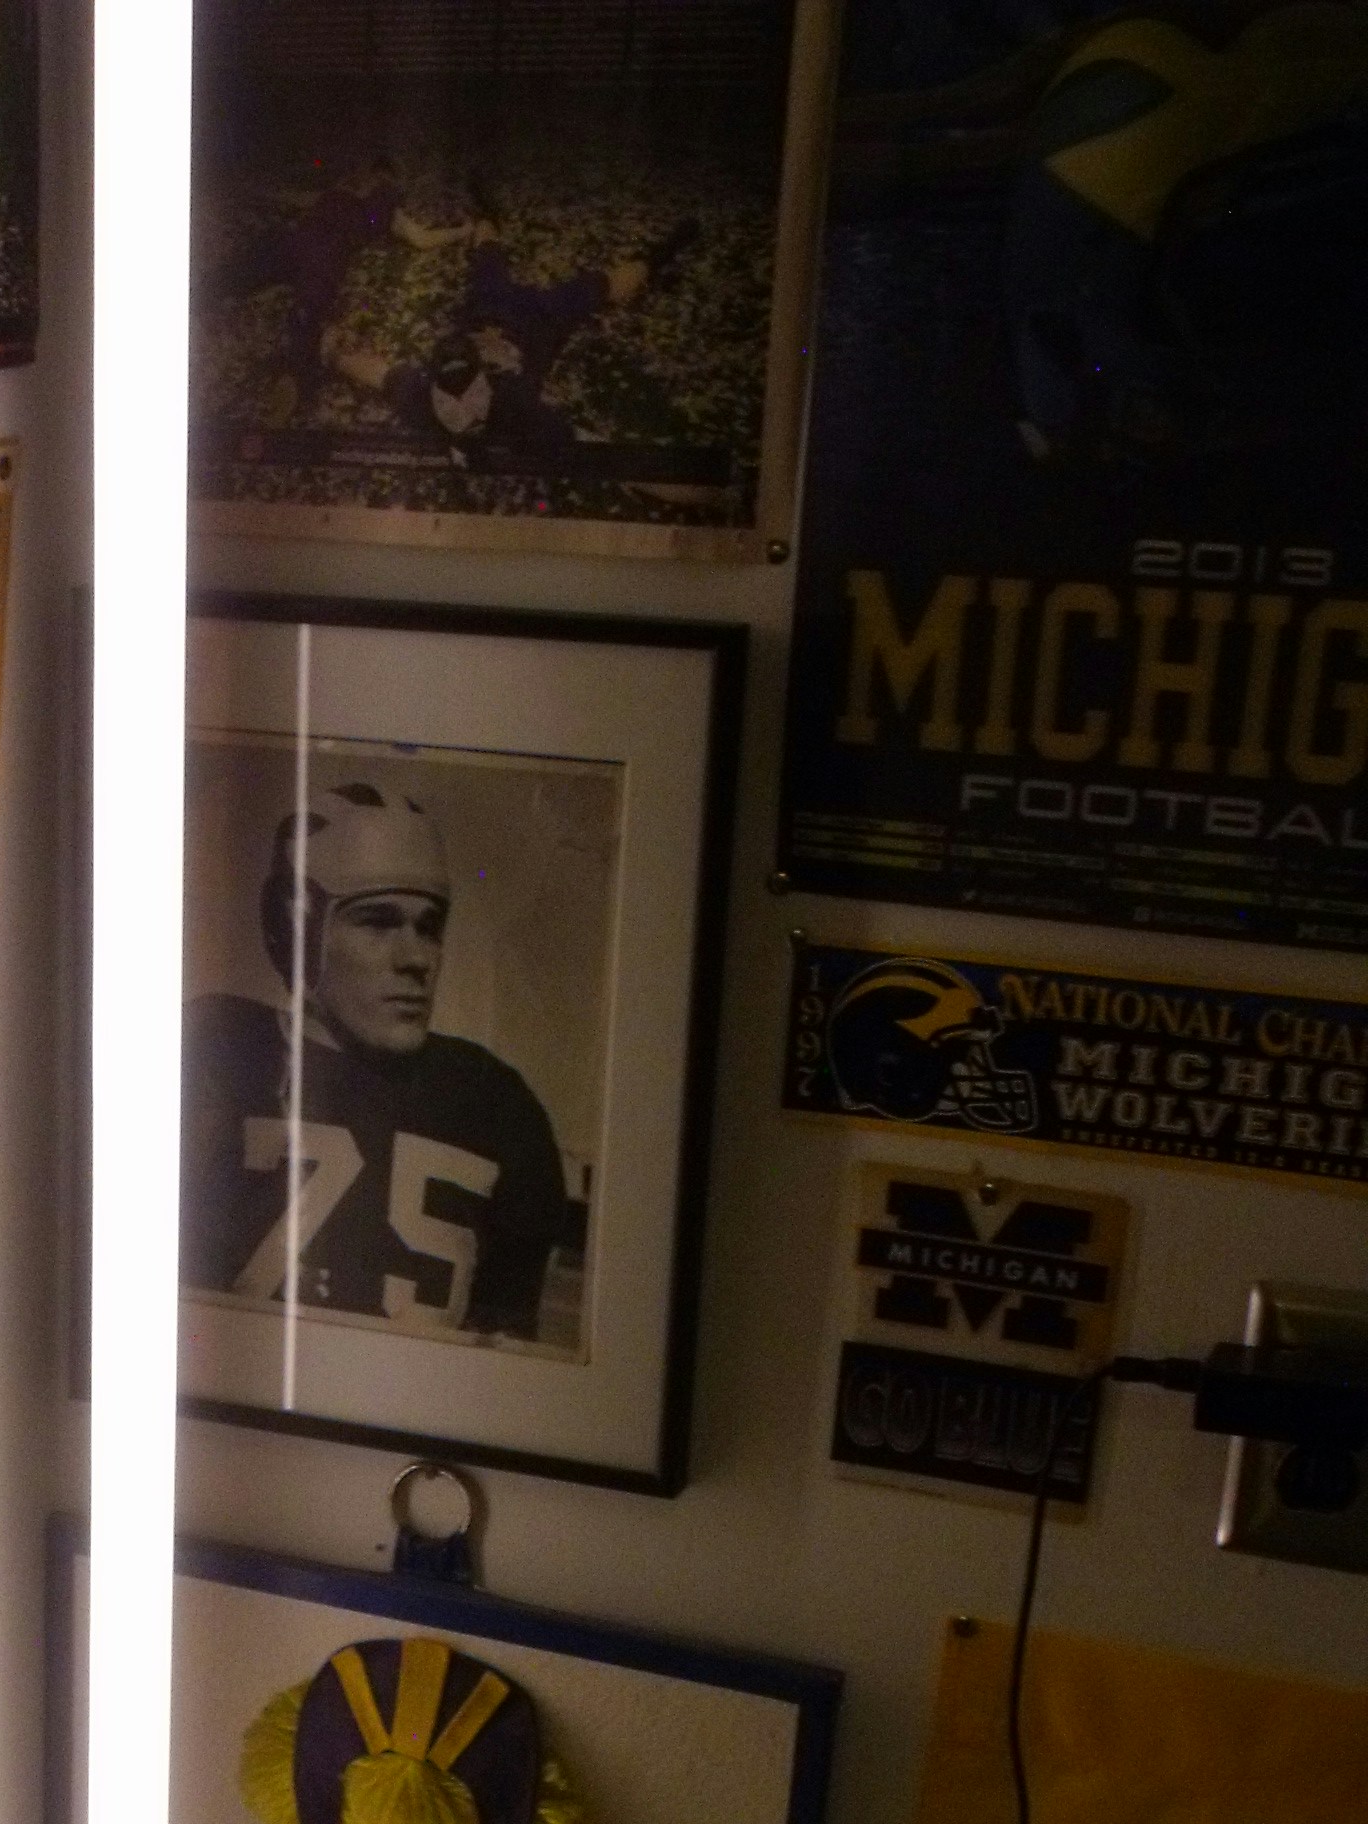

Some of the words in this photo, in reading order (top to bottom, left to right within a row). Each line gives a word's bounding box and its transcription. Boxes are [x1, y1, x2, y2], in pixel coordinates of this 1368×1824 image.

[1130, 539, 1336, 586] 2013
[832, 566, 1368, 786] MICHIG
[998, 972, 1242, 1045] NATIONAL
[1054, 1034, 1368, 1111] MICHIG
[231, 1116, 501, 1329] 75
[887, 1239, 1081, 1292] MICHIGAN
[843, 1362, 933, 1455] GO
